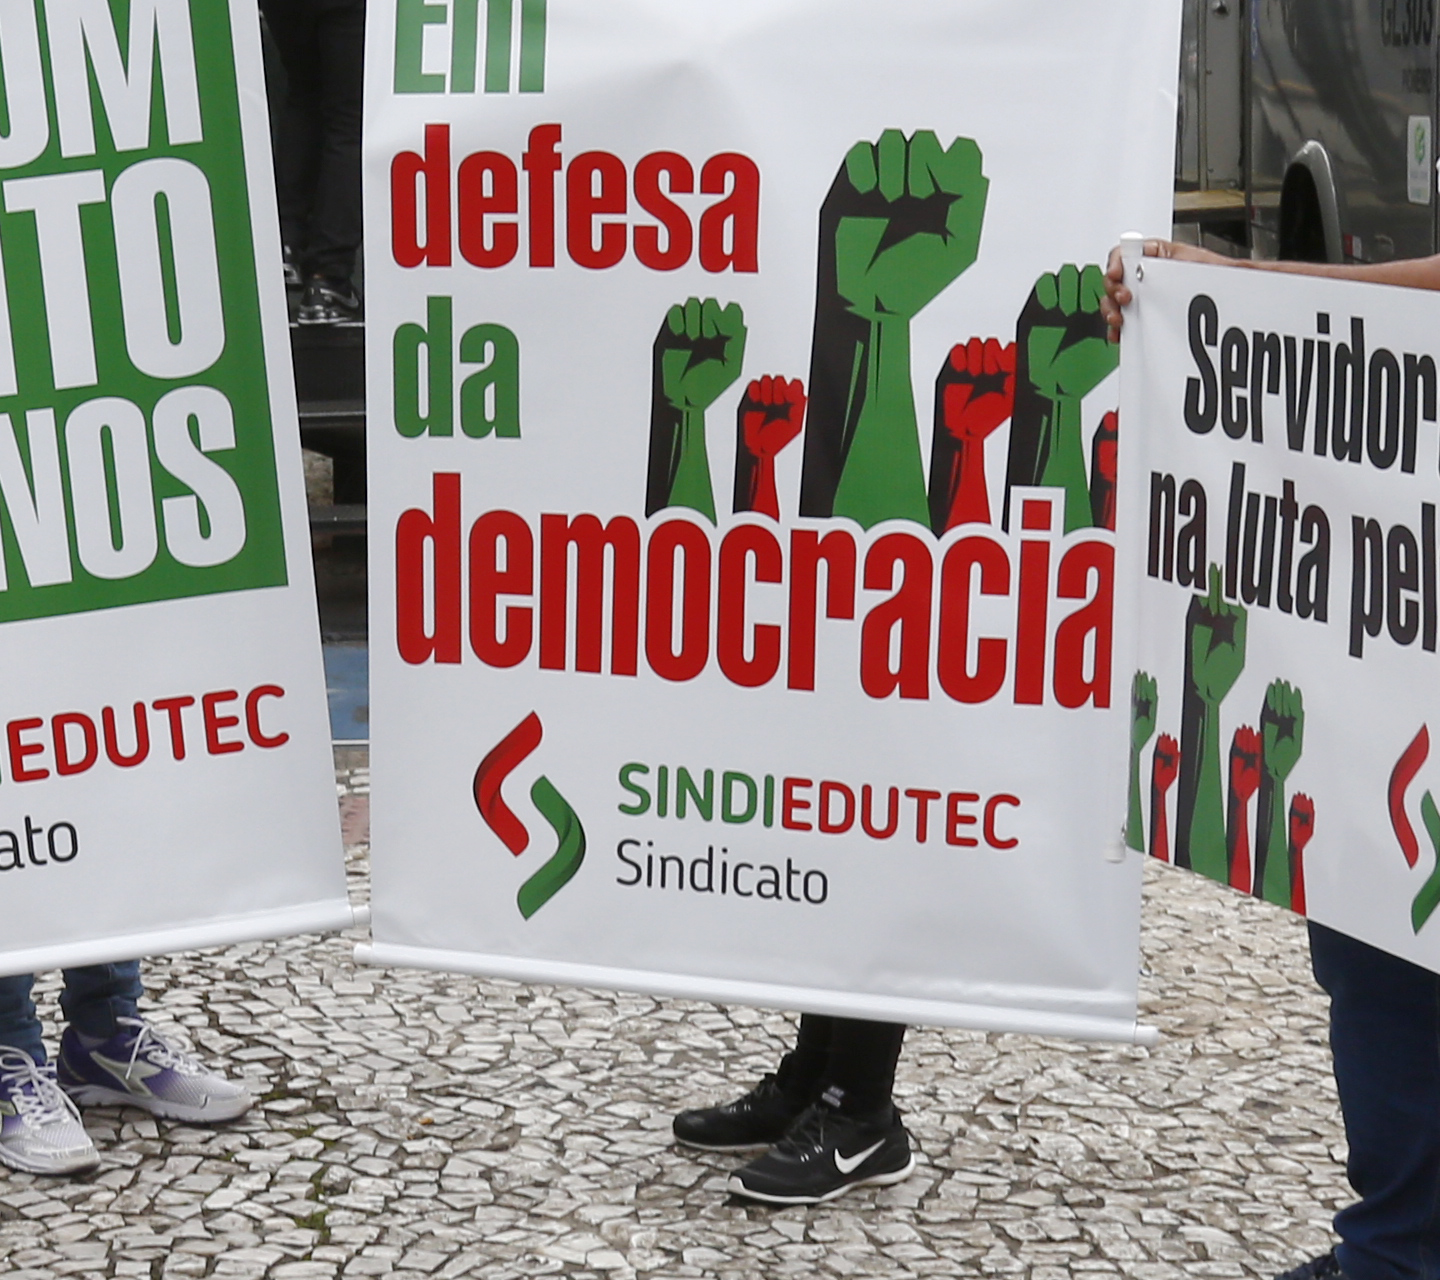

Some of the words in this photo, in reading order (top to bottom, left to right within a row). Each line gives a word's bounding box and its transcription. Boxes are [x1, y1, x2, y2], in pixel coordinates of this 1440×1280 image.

[390, 123, 761, 274] defesa
[392, 296, 521, 440] da
[390, 472, 1115, 710] democracia
[1146, 467, 1208, 592] na
[1223, 460, 1331, 624] luta
[615, 838, 830, 906] Sindicato
[616, 761, 1021, 852] SINDIEDUTEC
